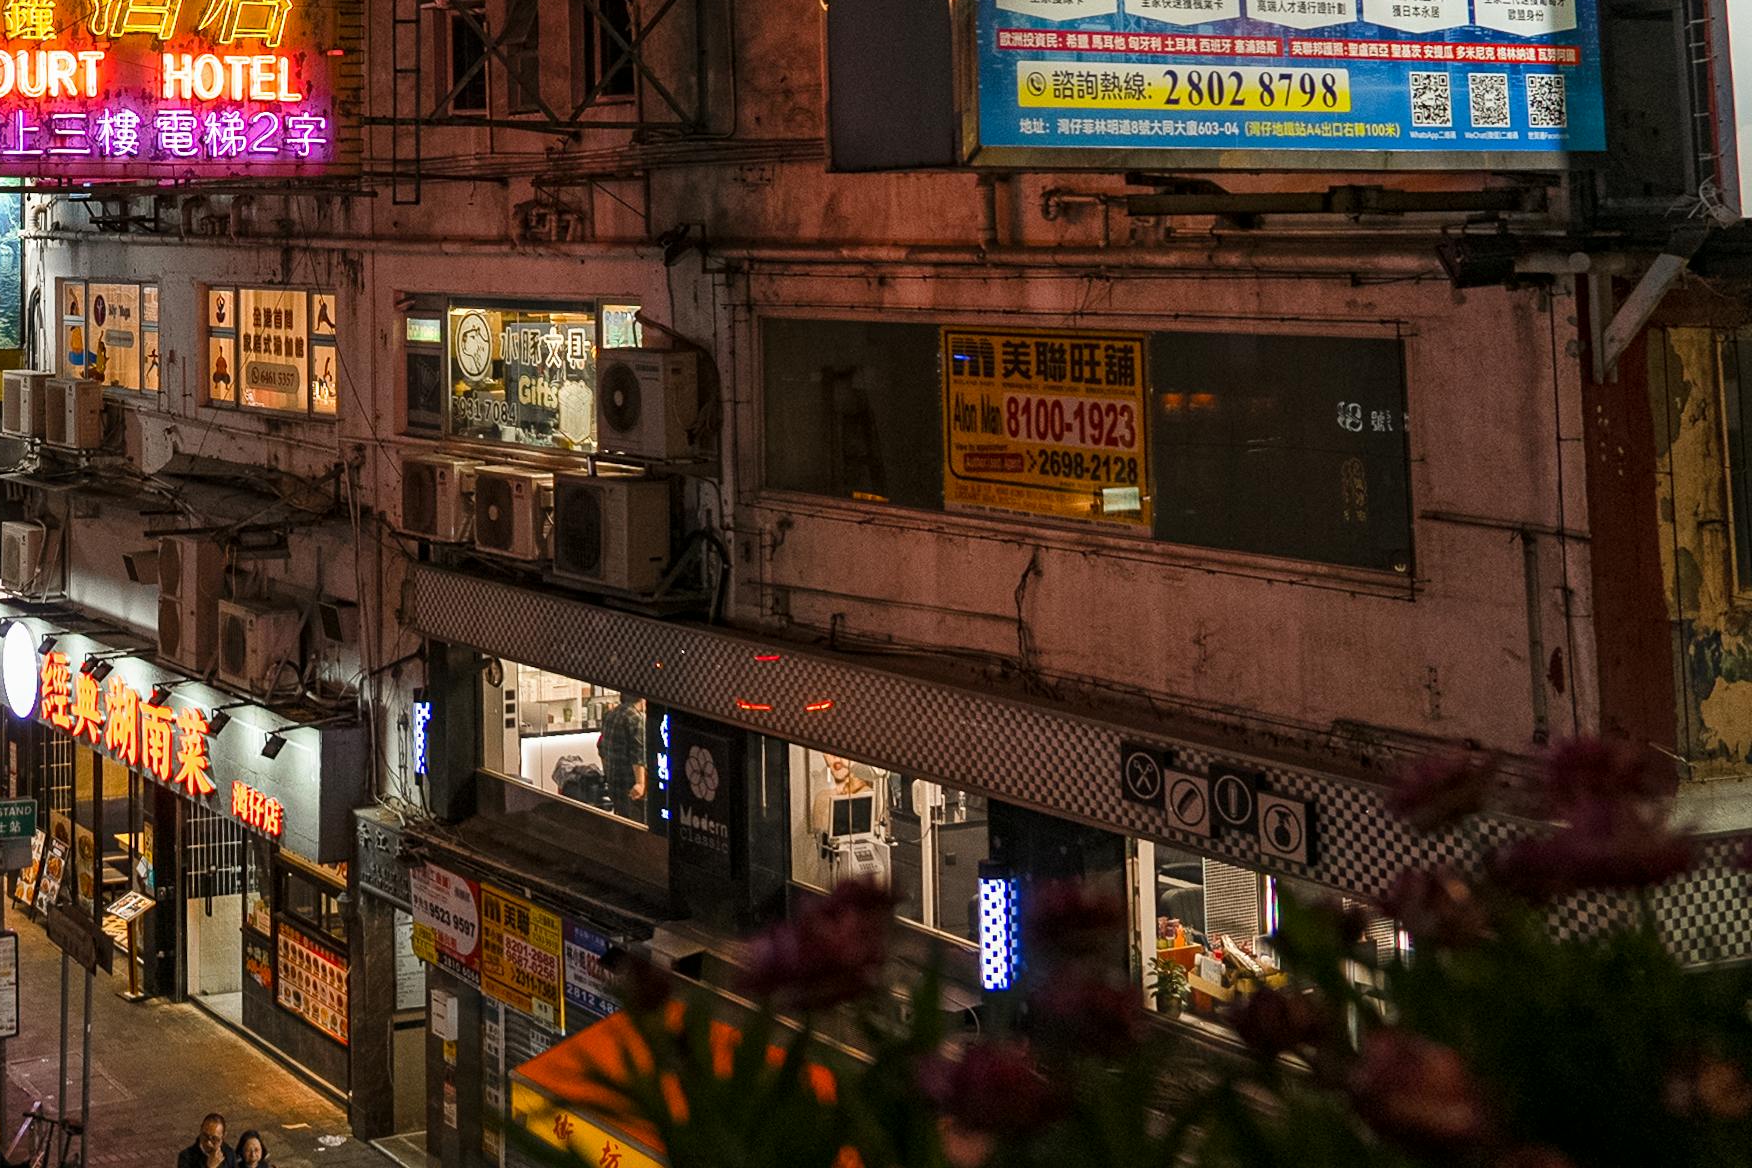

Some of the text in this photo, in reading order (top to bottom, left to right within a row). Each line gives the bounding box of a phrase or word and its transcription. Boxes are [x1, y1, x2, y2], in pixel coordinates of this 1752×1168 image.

[1507, 8, 1544, 22] 歐盟身份
[1200, 38, 1231, 53] 西班牙
[164, 53, 304, 104] HOTEL
[1163, 69, 1246, 106] 2802
[1259, 71, 1338, 108] 8798
[156, 112, 329, 160] 電梯2字
[500, 326, 590, 369] 水豚文具
[1002, 340, 1136, 387] 美聯旺舖
[519, 375, 559, 409] Gifts
[1006, 396, 1136, 449] 8100-1923
[1038, 449, 1138, 484] 2698-2128
[40, 651, 216, 796] 經典湖南菜
[232, 779, 284, 836] 灣仔店
[680, 803, 729, 838] Modern
[567, 983, 595, 1005] 2812
